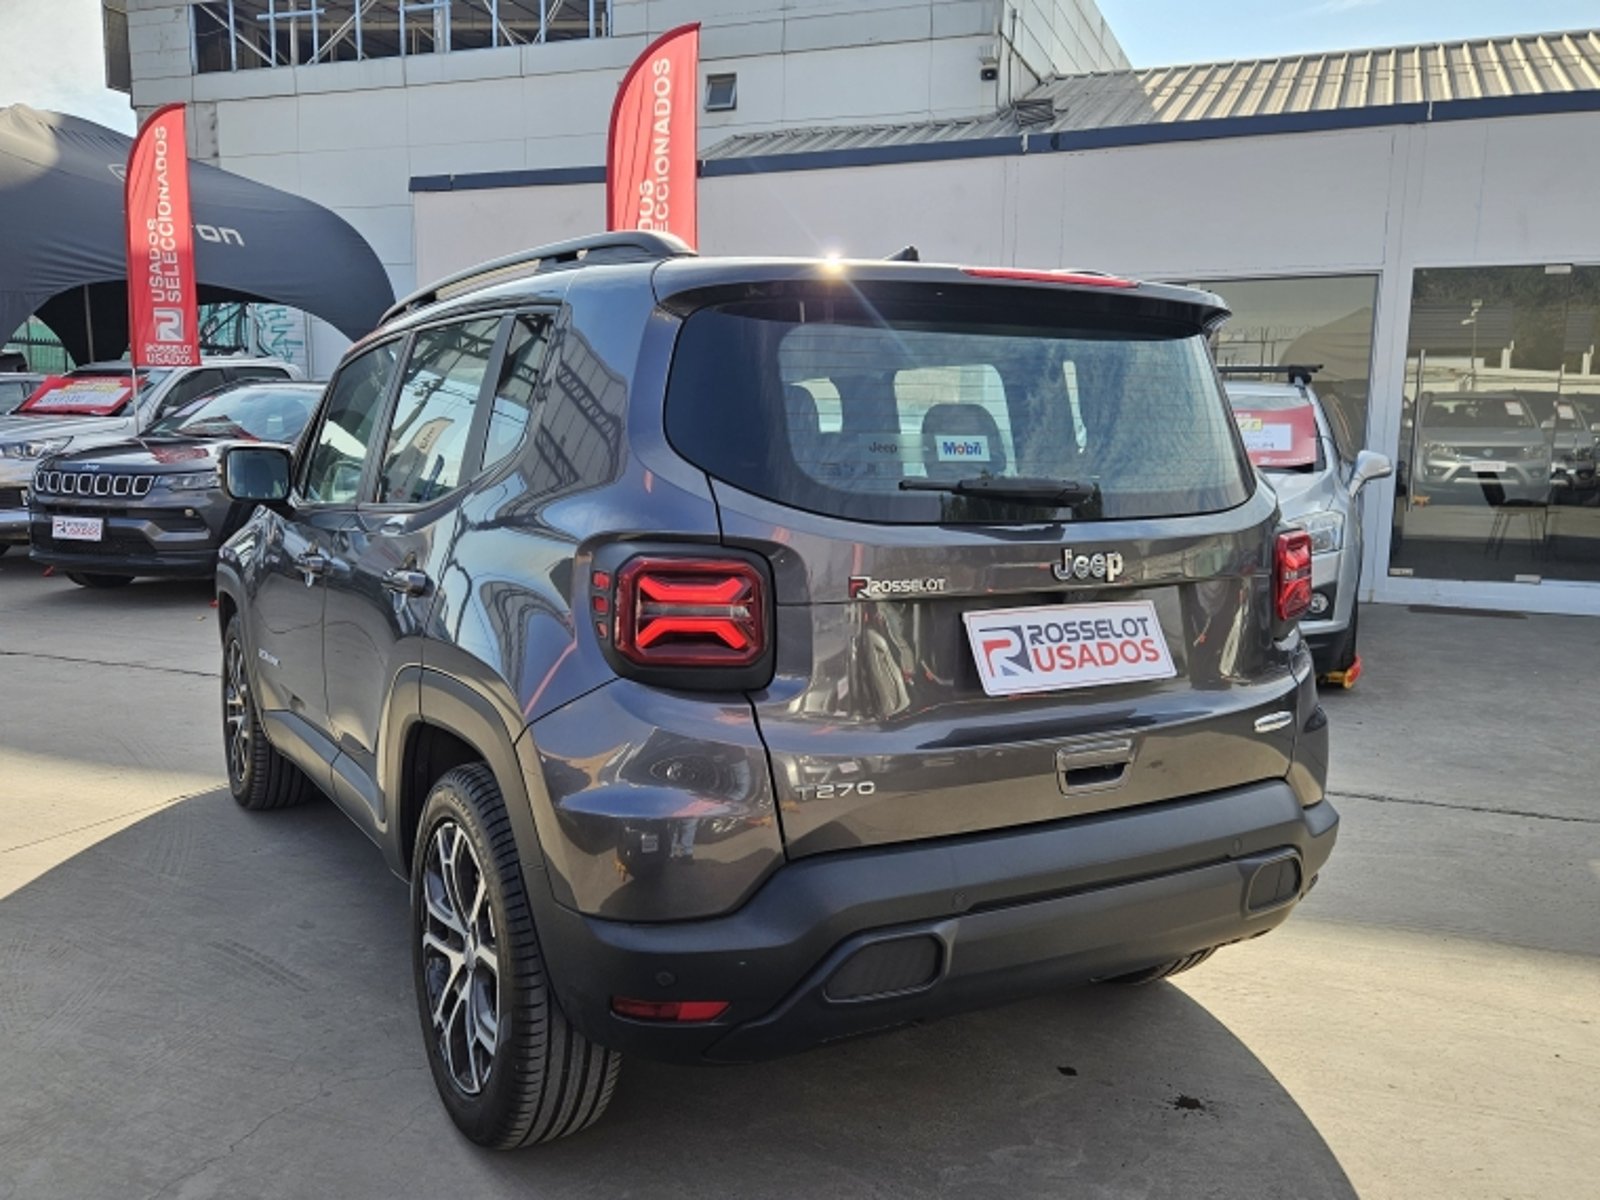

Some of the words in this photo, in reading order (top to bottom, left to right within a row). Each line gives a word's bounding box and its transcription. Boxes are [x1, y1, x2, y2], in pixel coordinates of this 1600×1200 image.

[653, 57, 671, 232] ECCIONADOS
[154, 126, 182, 303] SELECCIONADOS
[147, 218, 166, 302] USADOS
[147, 354, 192, 364] USADOS
[869, 441, 898, 454] Jeep
[942, 441, 982, 455] Mobil
[1053, 548, 1124, 582] Jeep
[1026, 617, 1150, 646] ROSSELOT
[1031, 639, 1161, 672] USADOS
[794, 781, 875, 800] T270
